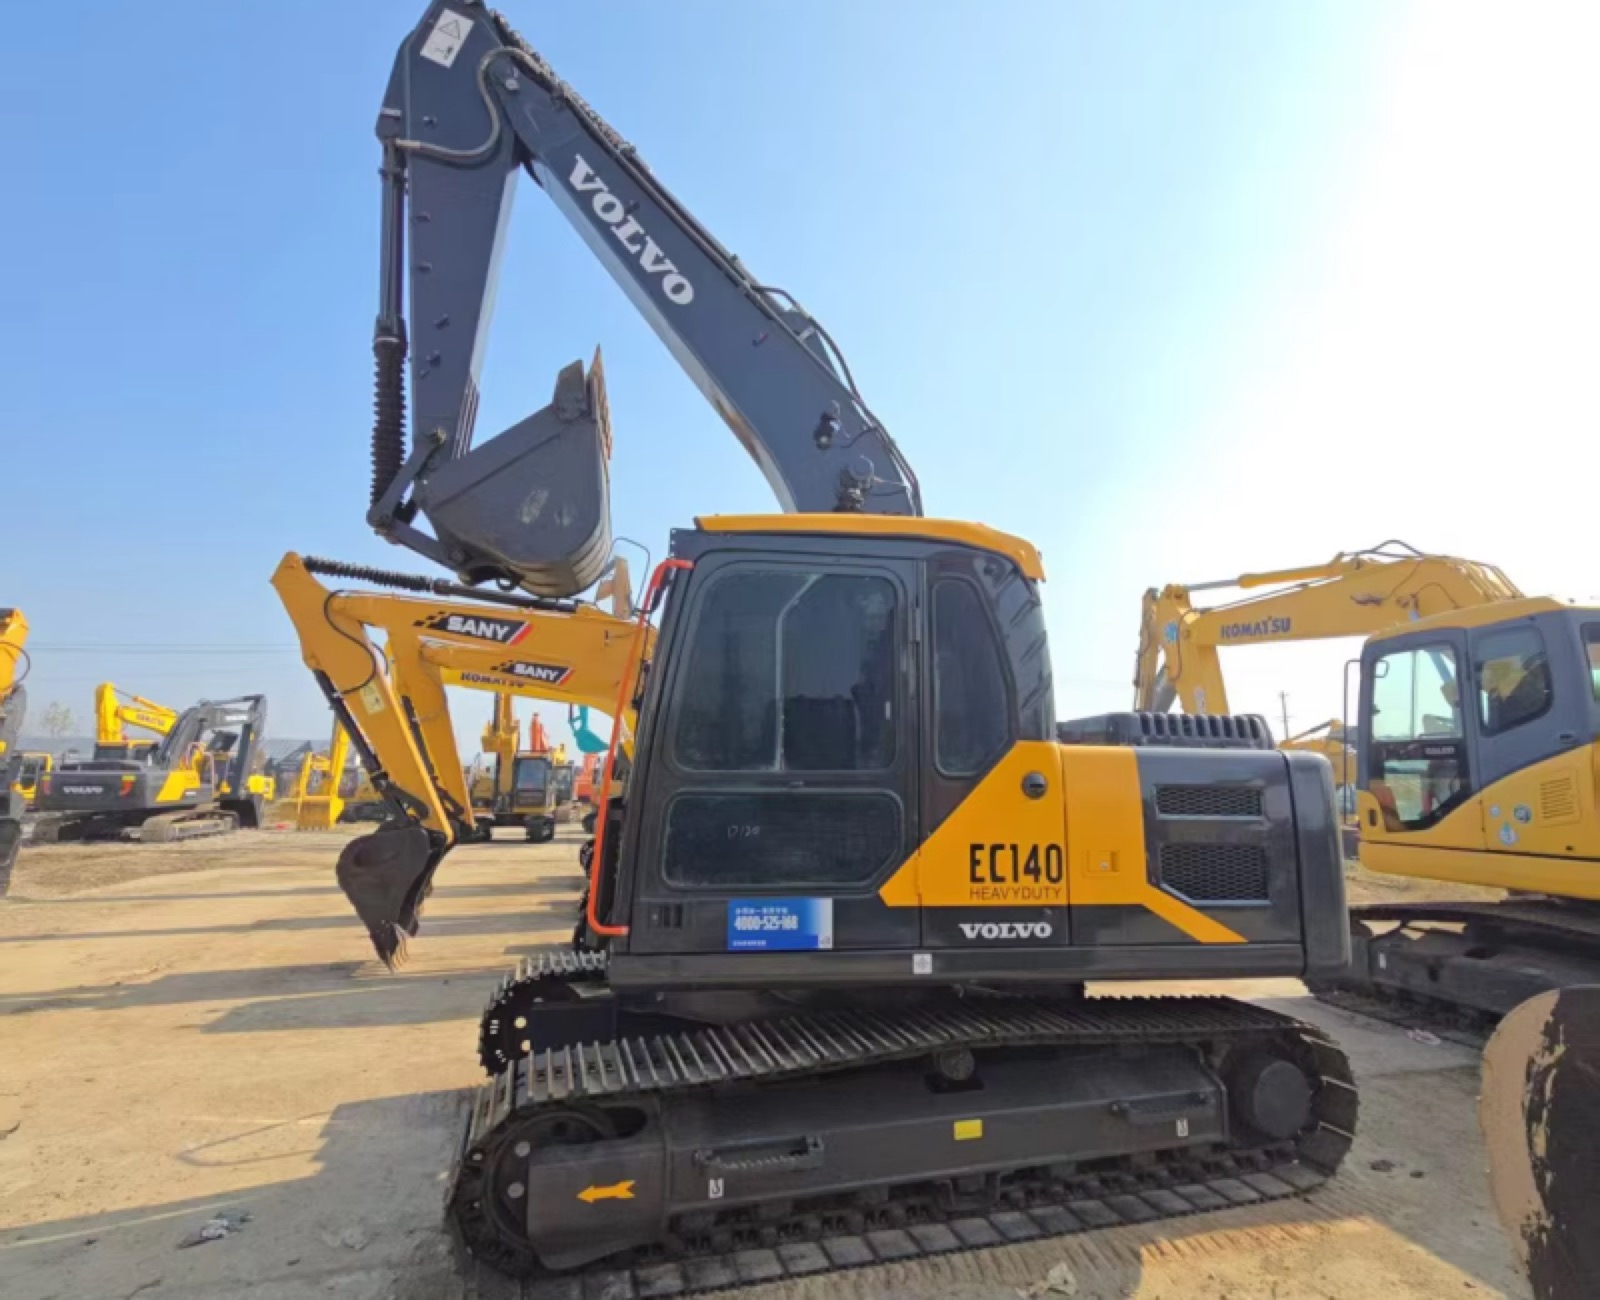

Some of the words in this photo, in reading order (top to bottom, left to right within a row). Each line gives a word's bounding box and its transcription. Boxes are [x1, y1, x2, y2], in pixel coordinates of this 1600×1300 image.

[569, 154, 694, 305] VOLVO
[446, 615, 510, 641] SANY
[1221, 615, 1291, 638] KOMATSU
[513, 663, 559, 681] SANY
[969, 843, 1063, 884] EC140
[969, 886, 1062, 900] HEAVYDUTY
[958, 922, 1052, 939] VOLVO
